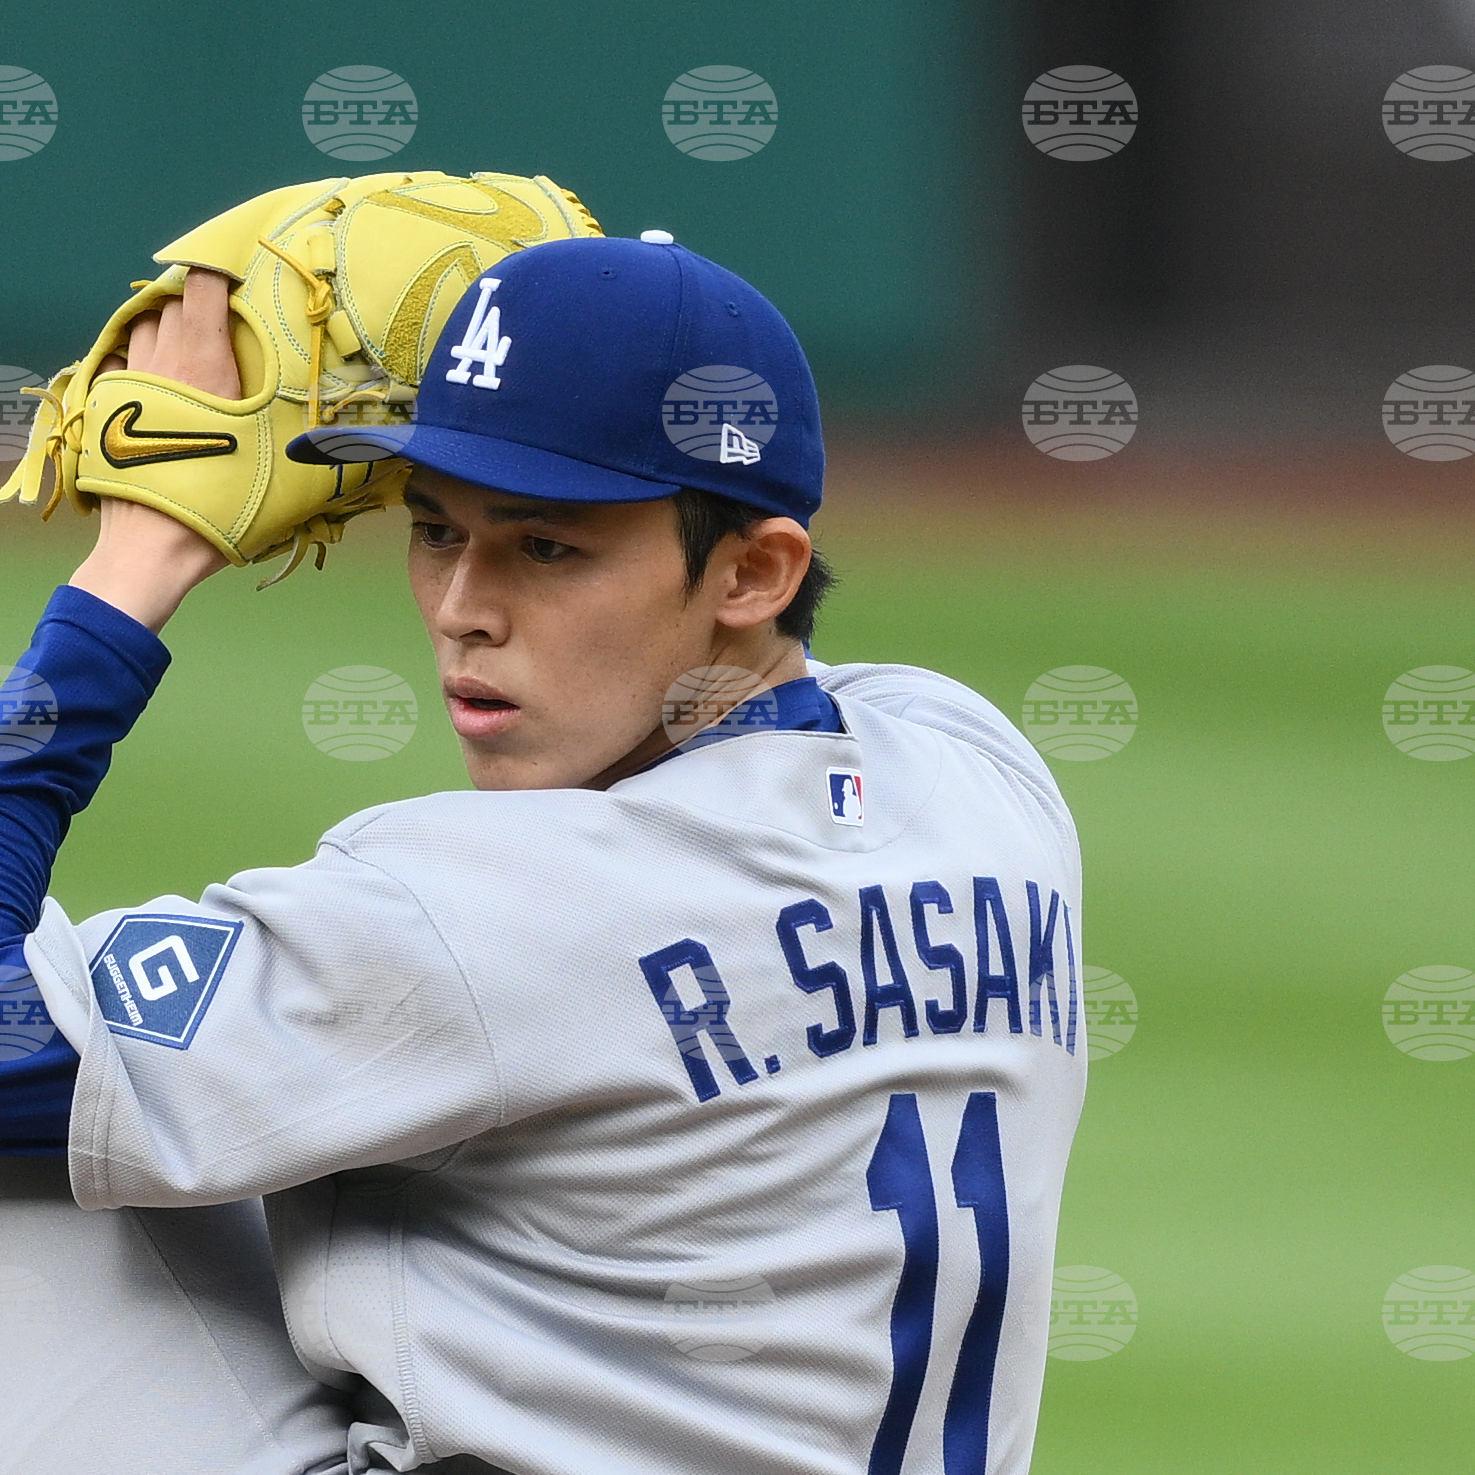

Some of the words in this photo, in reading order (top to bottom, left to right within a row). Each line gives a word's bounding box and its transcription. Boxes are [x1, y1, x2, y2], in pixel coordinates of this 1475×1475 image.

[445, 277, 513, 391] LA
[103, 953, 144, 1027] GUGGENHEIM
[128, 935, 200, 1001] G
[638, 937, 781, 1103] R.
[776, 876, 1077, 1057] SASAKI
